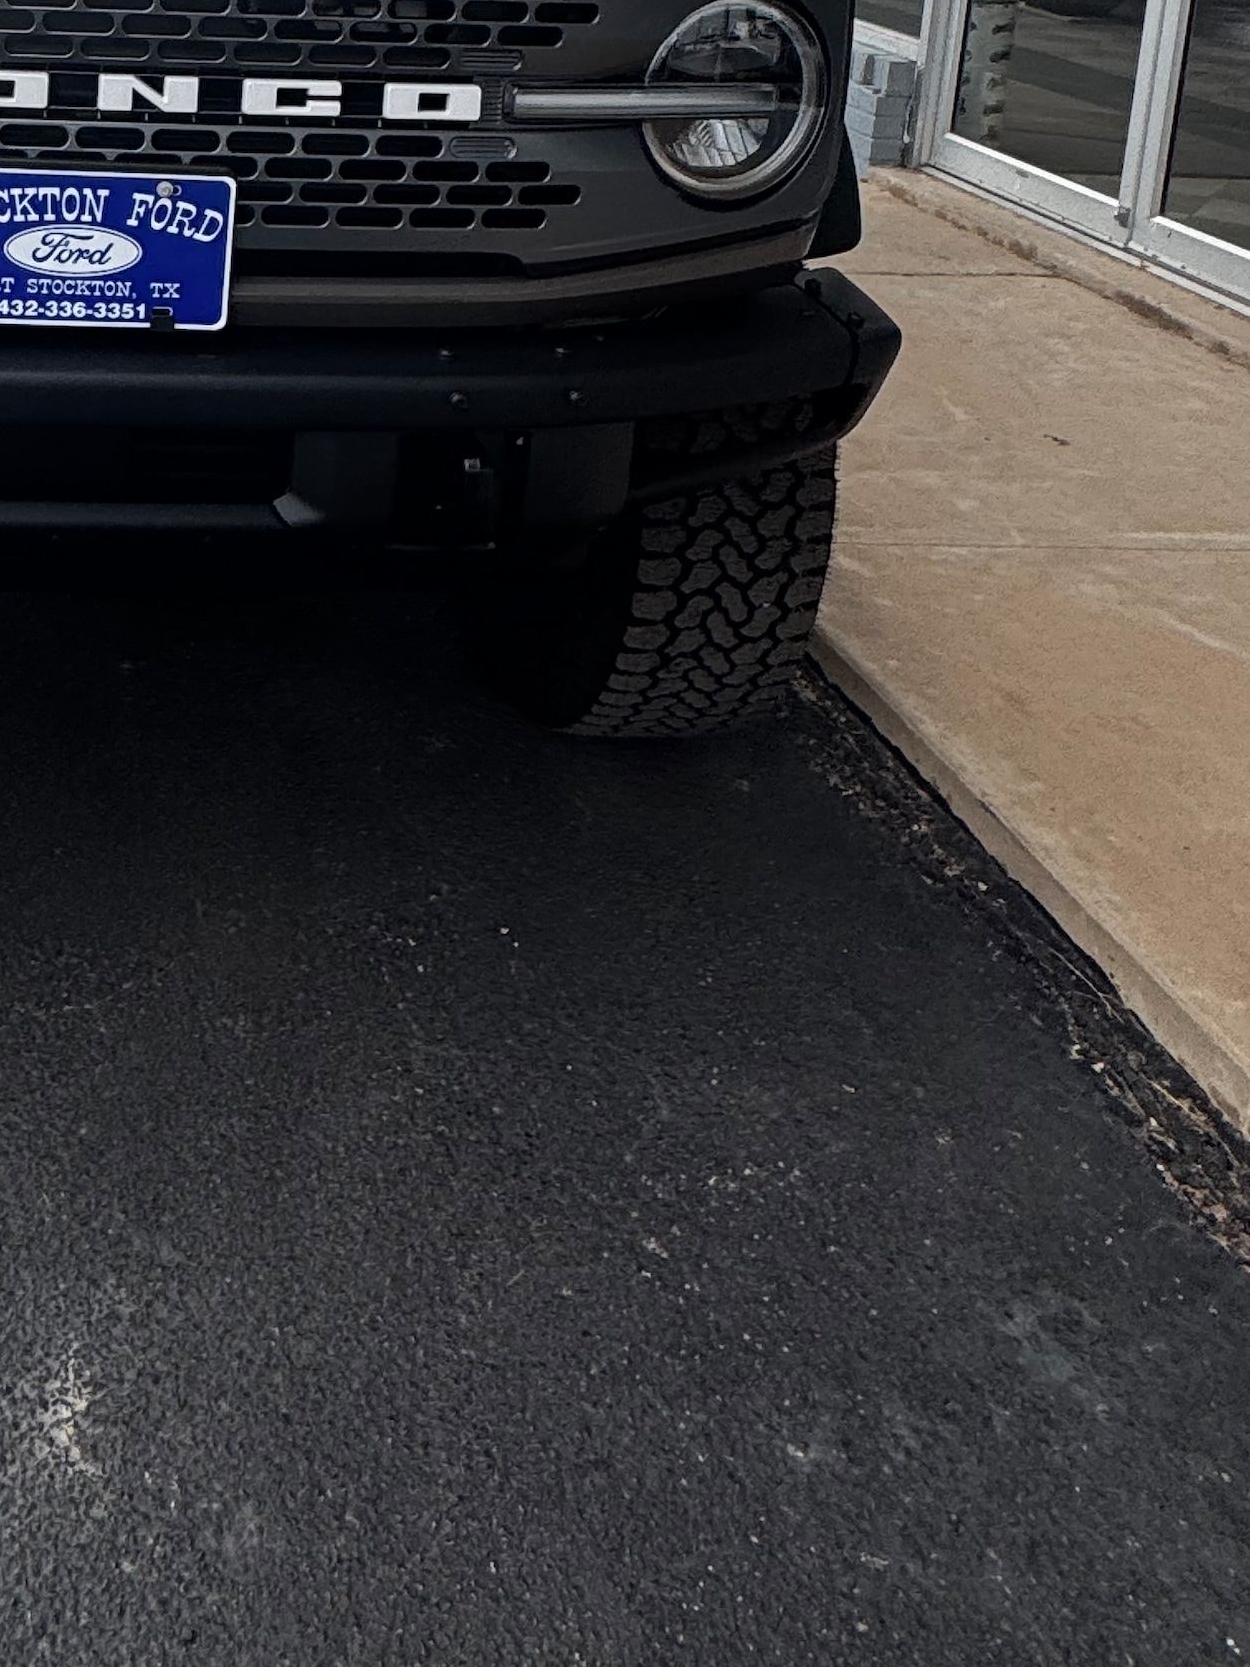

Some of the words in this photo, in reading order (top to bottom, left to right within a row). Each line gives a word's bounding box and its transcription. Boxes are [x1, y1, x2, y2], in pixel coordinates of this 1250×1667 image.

[126, 192, 224, 243] FORD
[32, 231, 113, 266] Ford
[151, 281, 180, 299] TX
